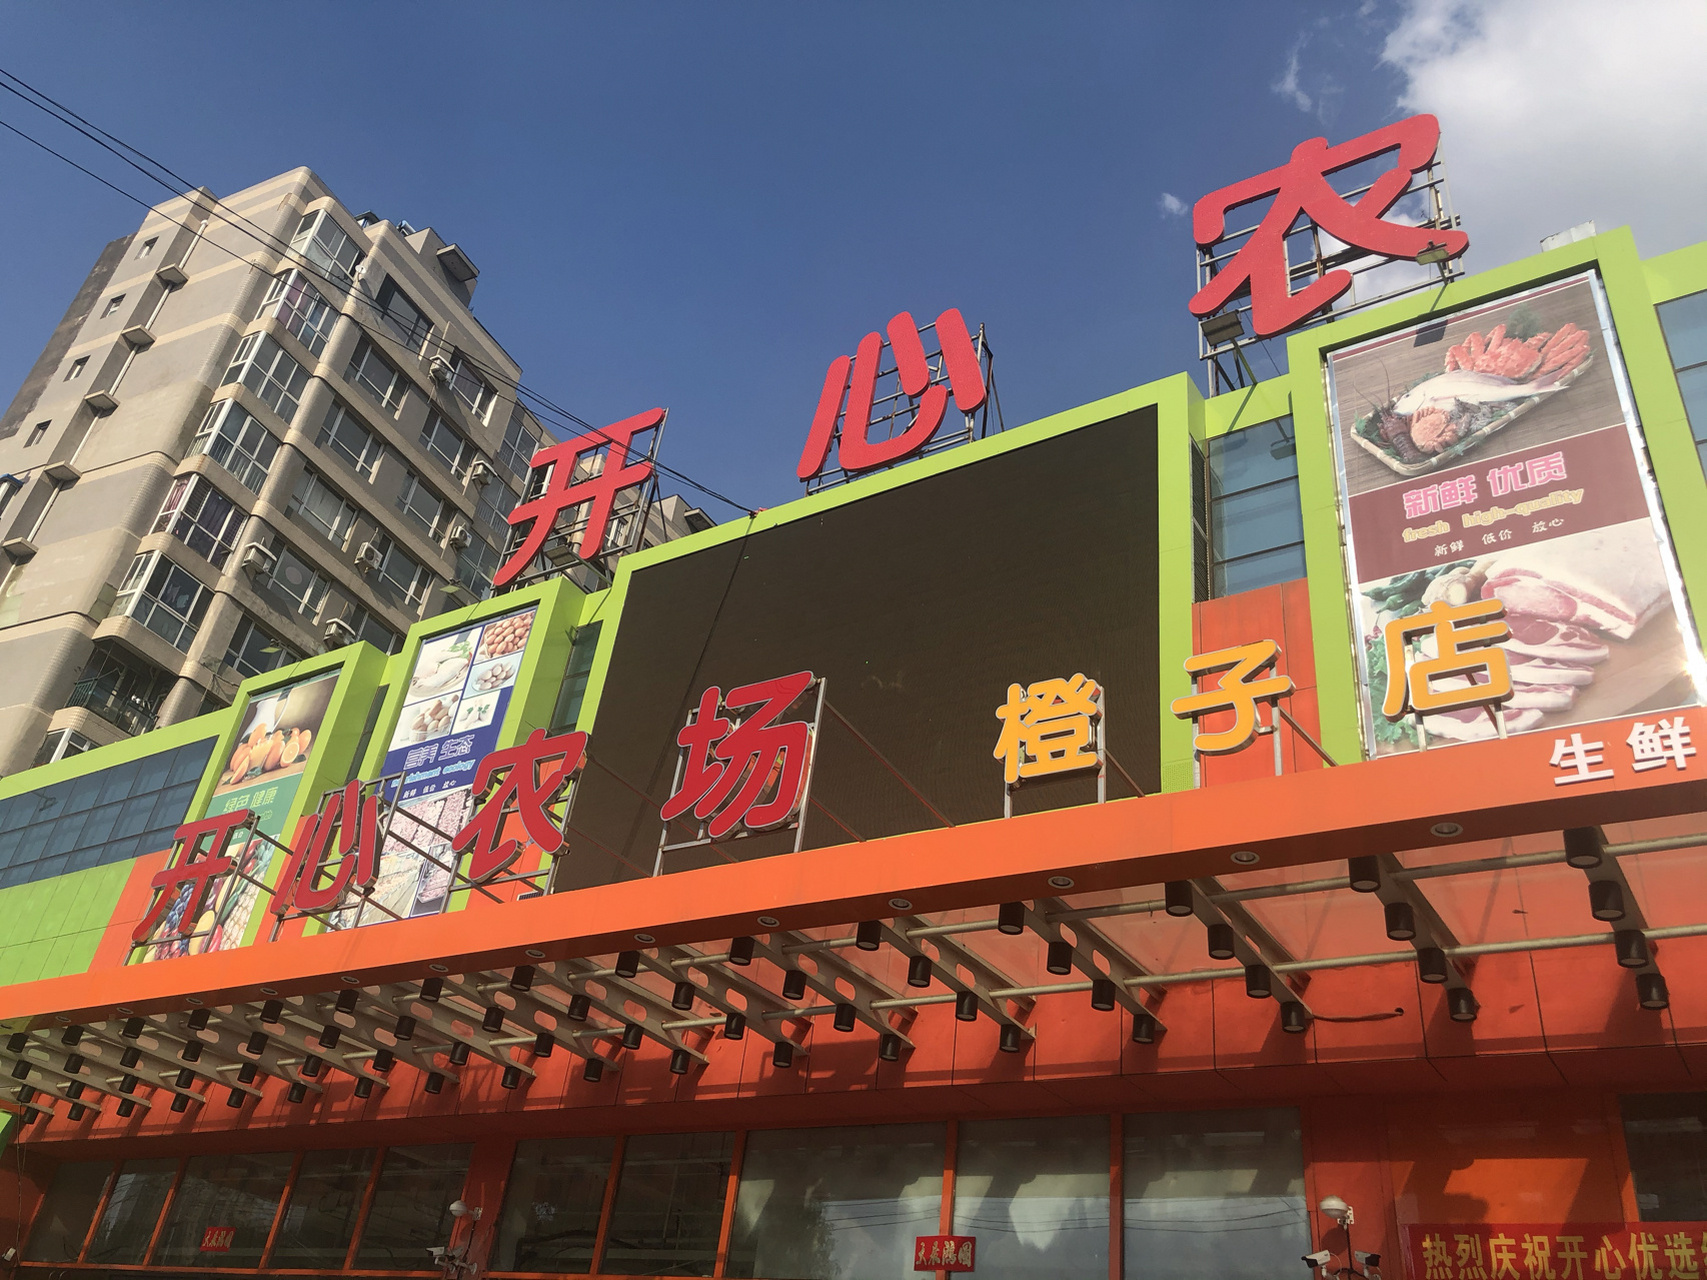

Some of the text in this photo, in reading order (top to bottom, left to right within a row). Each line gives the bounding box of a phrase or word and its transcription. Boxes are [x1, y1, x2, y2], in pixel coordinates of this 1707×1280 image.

[1403, 451, 1567, 519] 新鲜 优质
[1402, 489, 1584, 543] fresh high-quality
[1434, 518, 1564, 557] 新鲜 低价 放心
[131, 599, 1515, 945] 开心农场 橙子店
[403, 734, 475, 770] 营养 生态
[1548, 716, 1697, 787] 生鲜
[1422, 1232, 1707, 1280] 热烈庆祝开心优选
